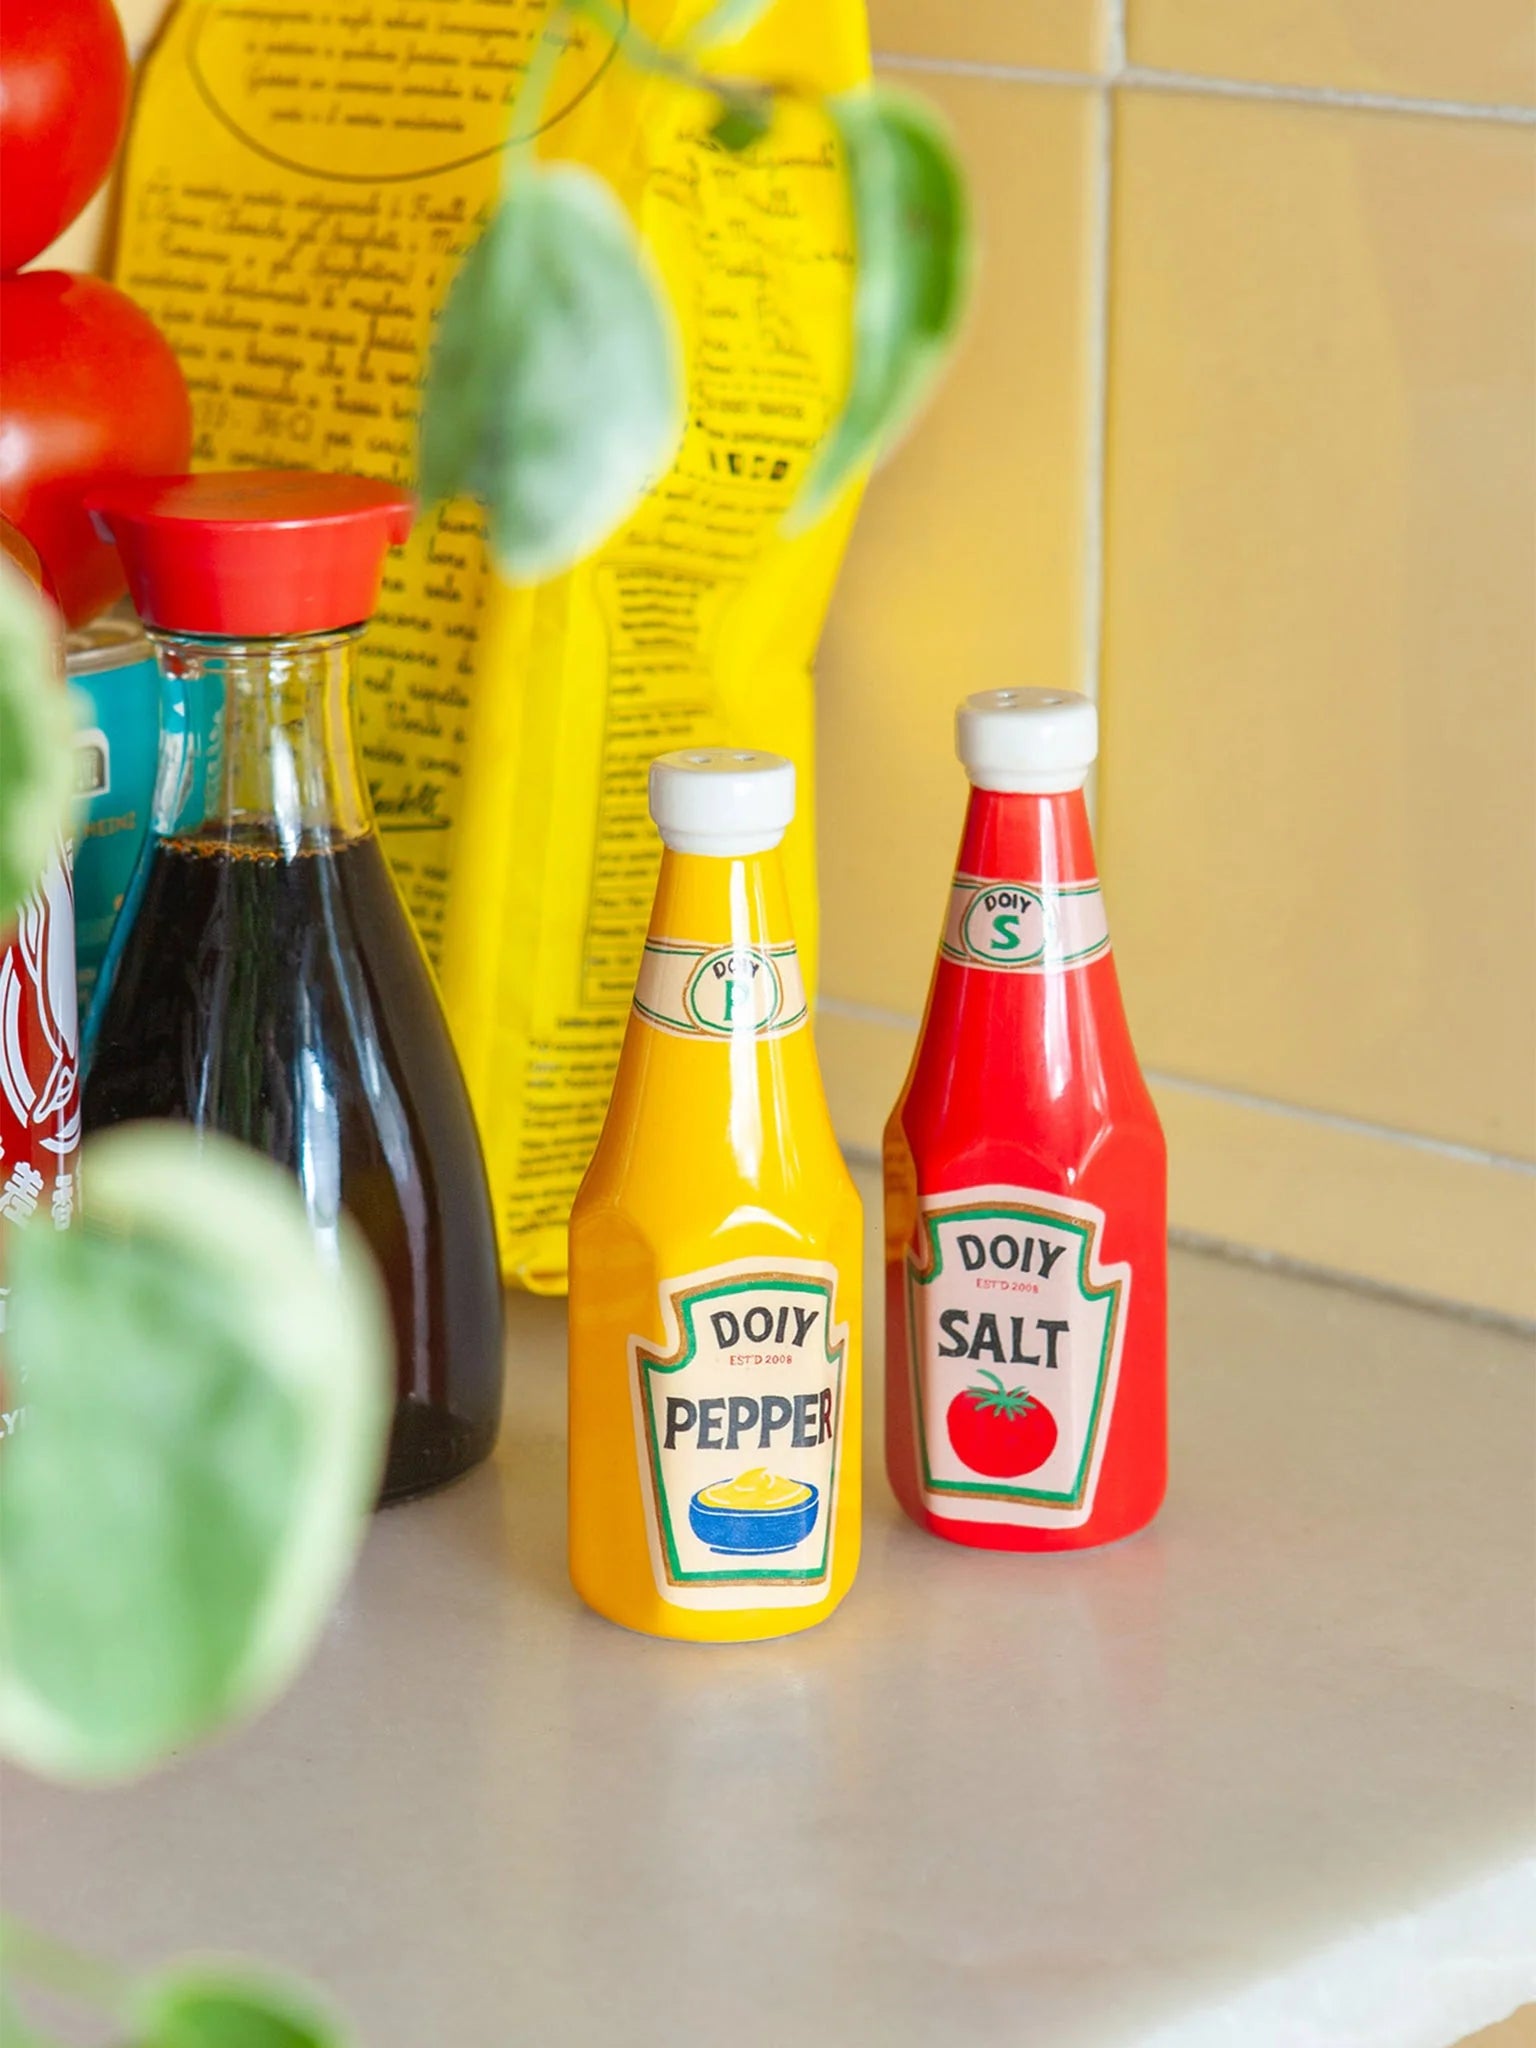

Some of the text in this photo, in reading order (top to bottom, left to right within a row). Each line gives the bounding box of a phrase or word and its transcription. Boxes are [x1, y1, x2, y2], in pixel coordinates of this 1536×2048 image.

[984, 892, 1031, 914] DOIY
[990, 914, 1021, 950] S
[712, 957, 760, 980] DOY
[956, 1234, 1067, 1279] DOIY
[1011, 1281, 1039, 1294] 2008
[709, 1306, 820, 1350] DOIY
[937, 1308, 1070, 1369] SALT
[729, 1354, 793, 1367] EST'D 2008
[663, 1387, 833, 1450] PEPPER
